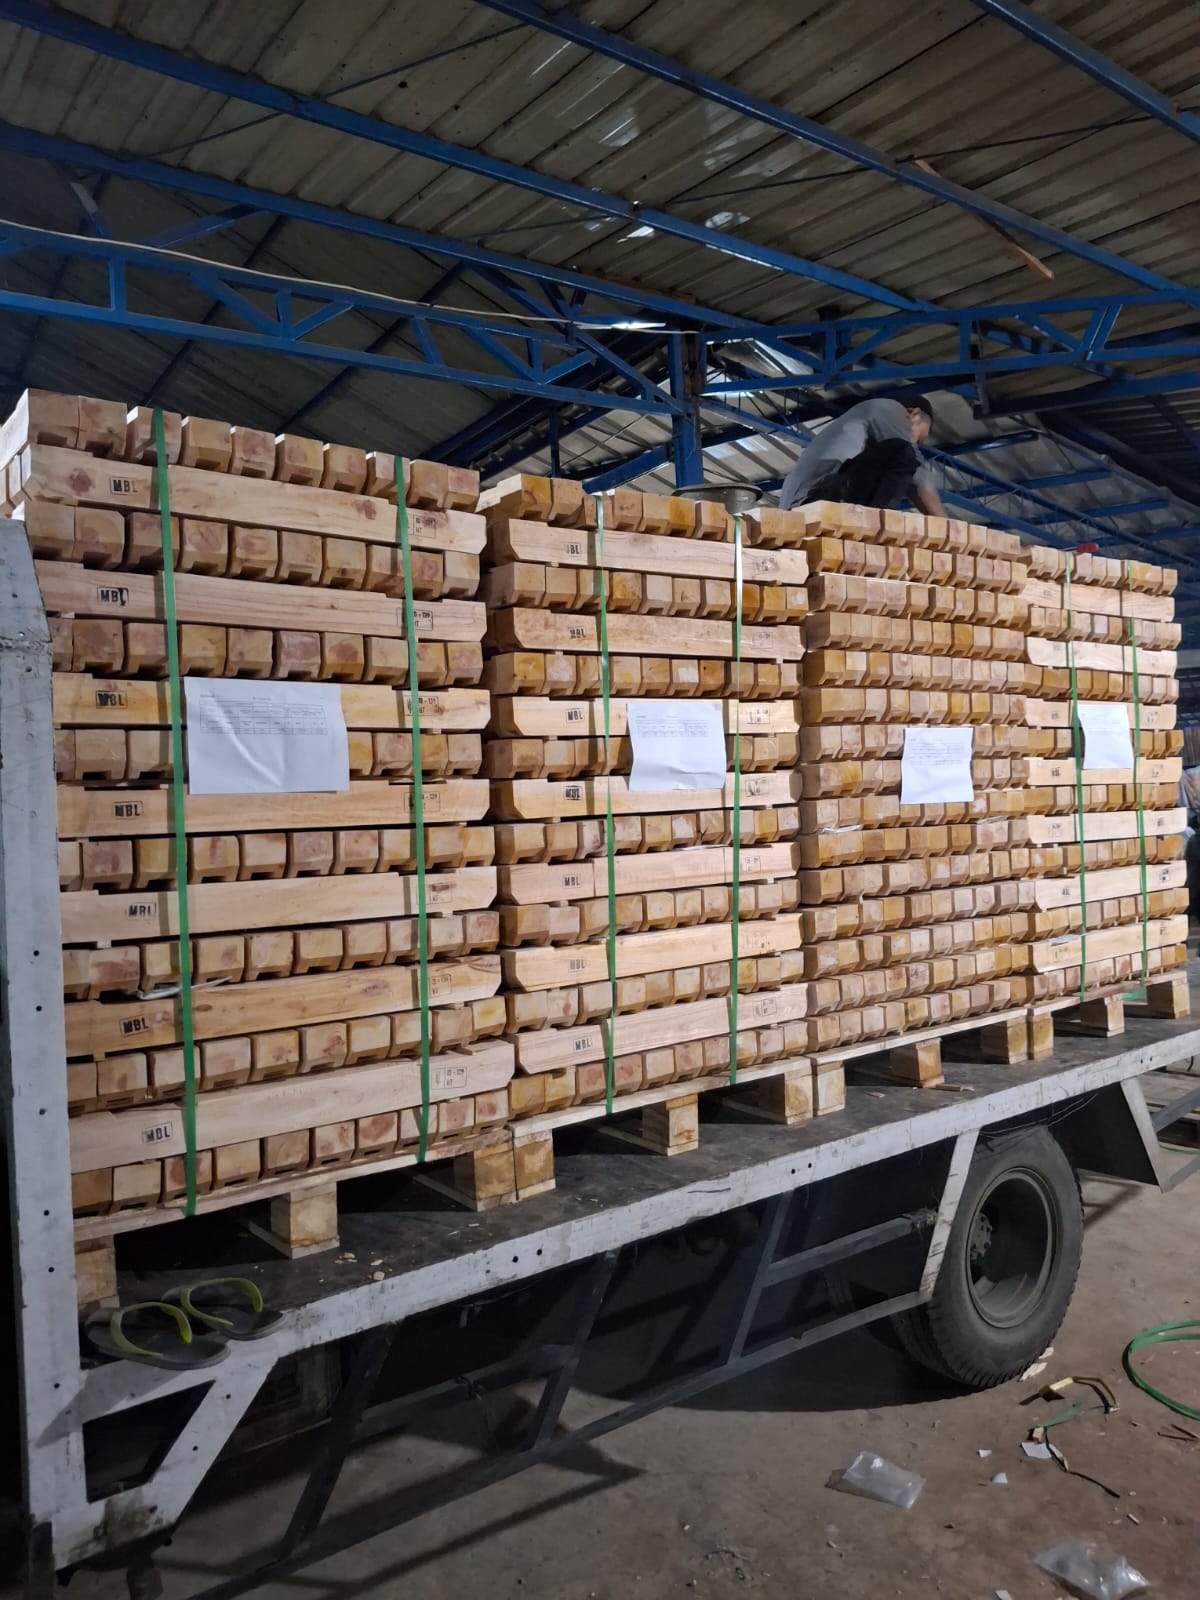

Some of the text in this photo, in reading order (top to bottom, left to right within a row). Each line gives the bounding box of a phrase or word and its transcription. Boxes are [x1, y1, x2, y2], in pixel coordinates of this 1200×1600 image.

[567, 710, 583, 721] MBL
[115, 804, 141, 817] MBL
[564, 876, 580, 887] MBL
[123, 1017, 149, 1034] MBL
[146, 1126, 170, 1143] MBL
